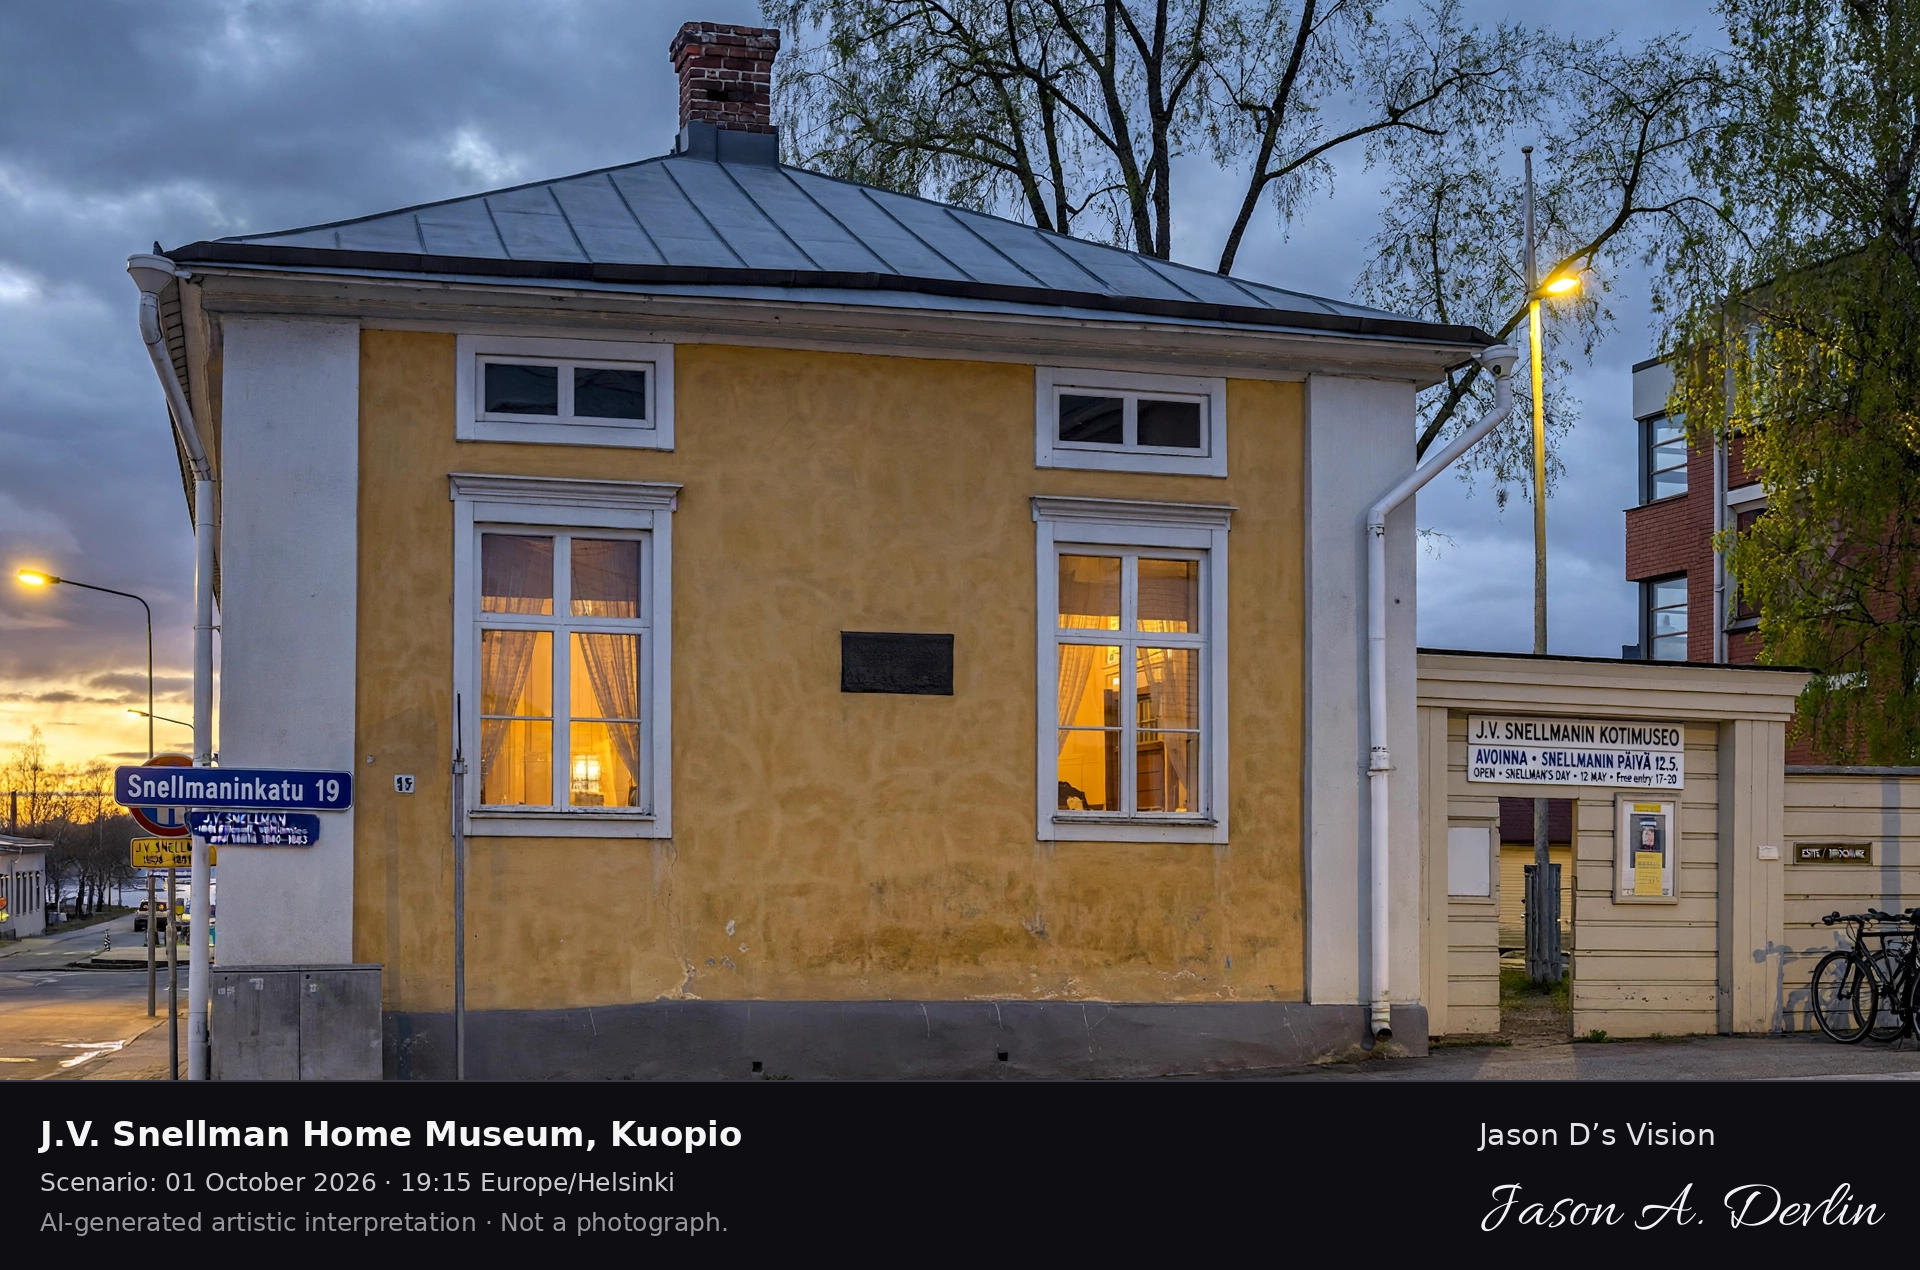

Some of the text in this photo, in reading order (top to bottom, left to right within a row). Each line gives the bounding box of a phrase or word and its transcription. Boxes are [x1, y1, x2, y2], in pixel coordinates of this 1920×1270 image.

[1475, 720, 1680, 746] J.V. SNELLMANIN KOTIMUSEO
[1475, 748, 1678, 771] AVOINNA SNELLMANIN PÄIVÄ 12.5.
[1473, 767, 1496, 779] OPEN
[1555, 770, 1571, 781] DAY
[1580, 771, 1589, 781] 12
[1591, 771, 1607, 782] MAY
[1616, 772, 1632, 783] Free
[127, 773, 340, 802] Snellmaninkatu 19
